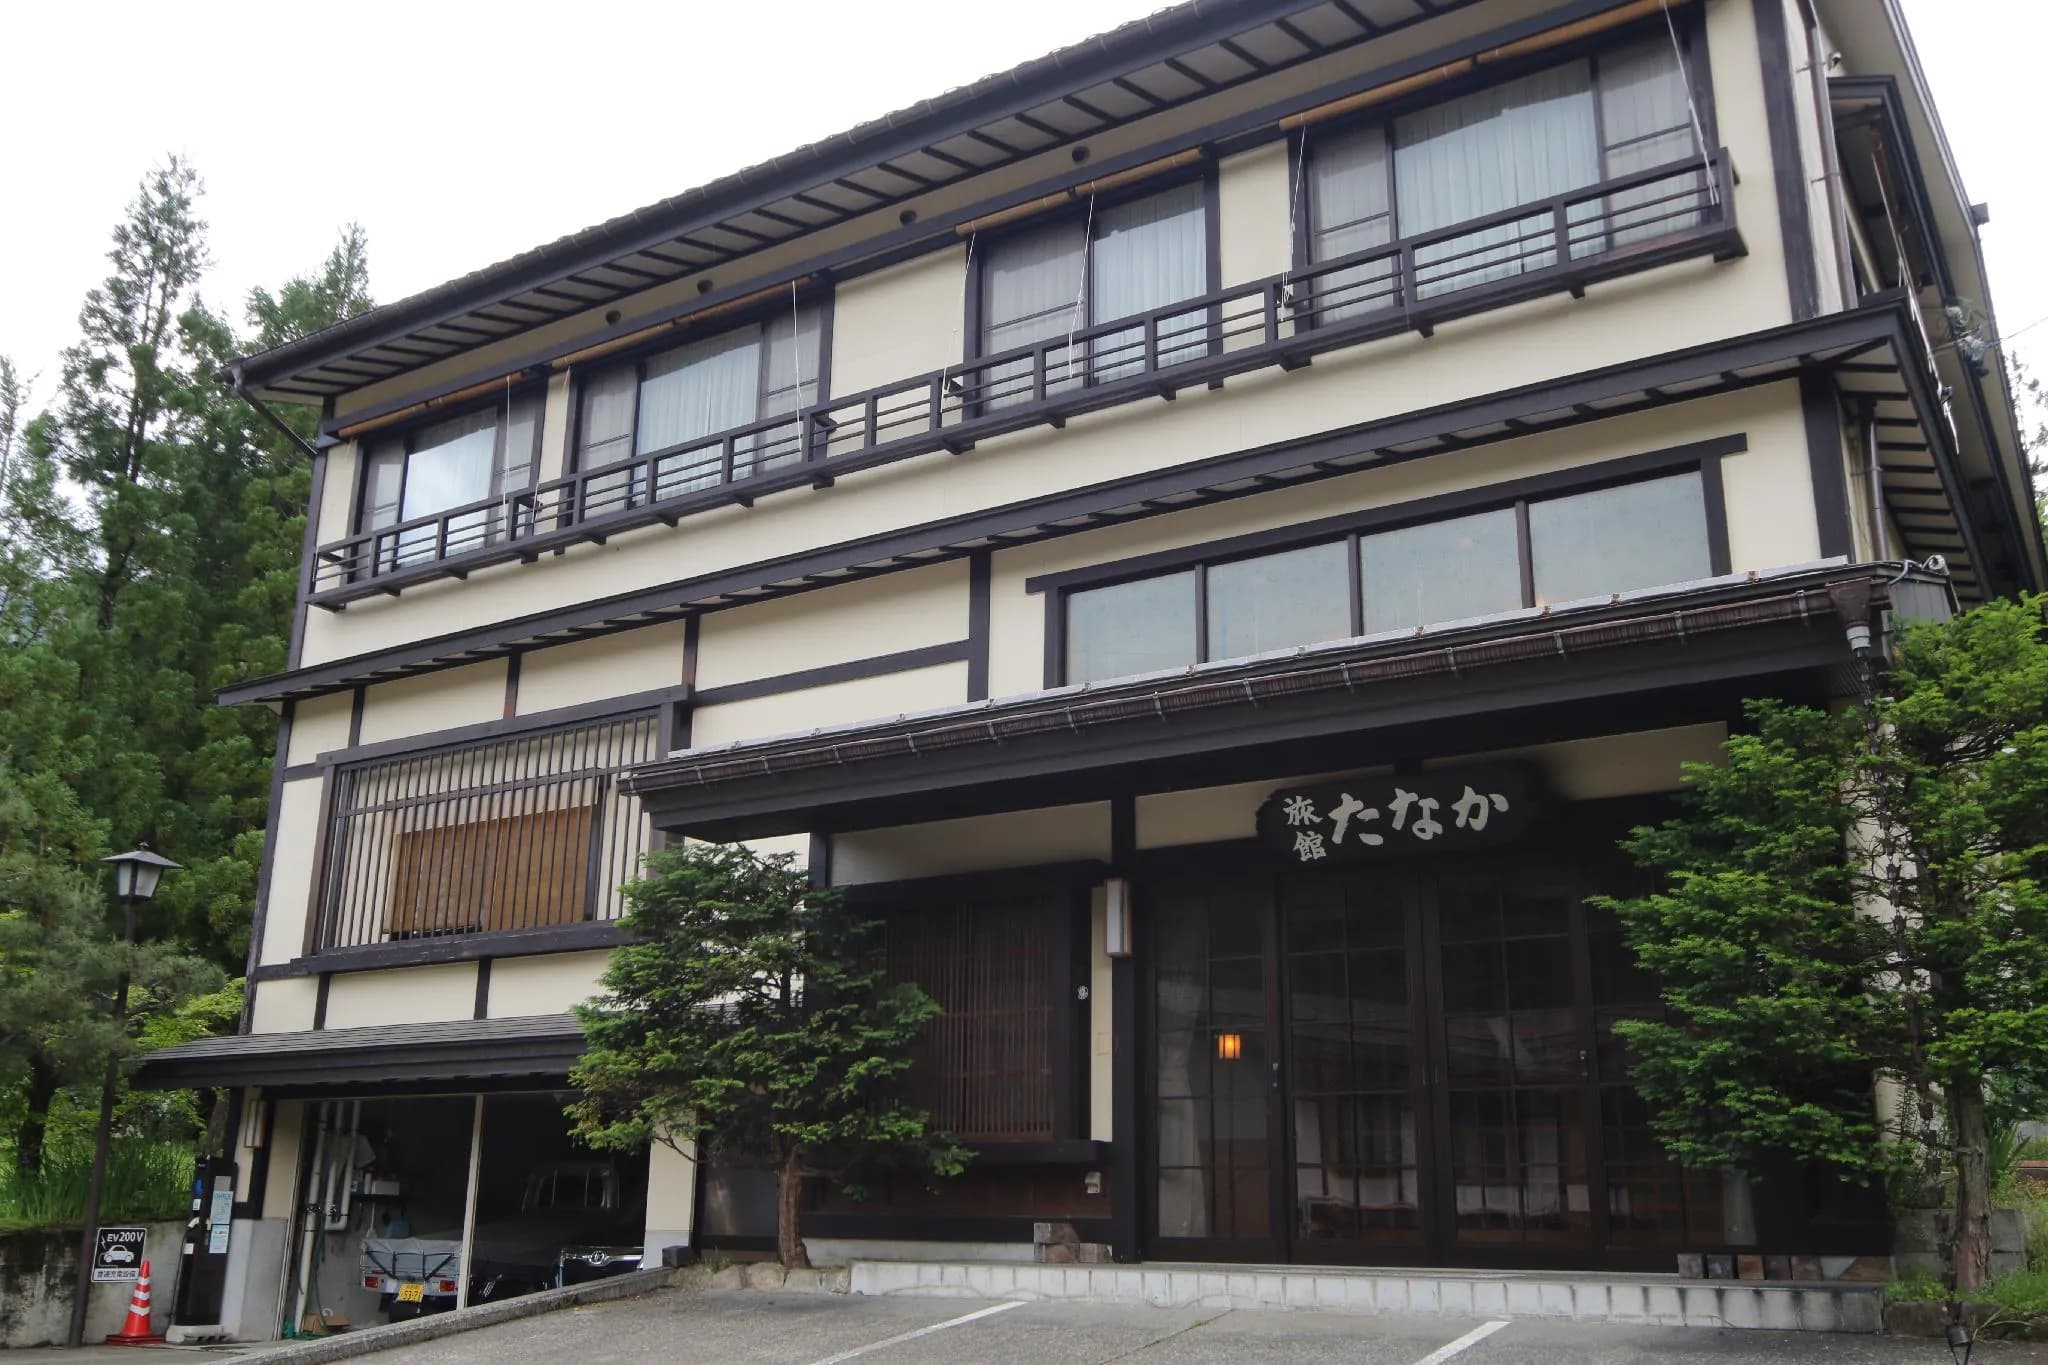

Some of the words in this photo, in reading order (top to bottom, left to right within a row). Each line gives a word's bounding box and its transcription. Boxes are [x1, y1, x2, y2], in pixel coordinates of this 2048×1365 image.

[1283, 795, 1326, 861] 旅館
[1328, 786, 1509, 845] たなか
